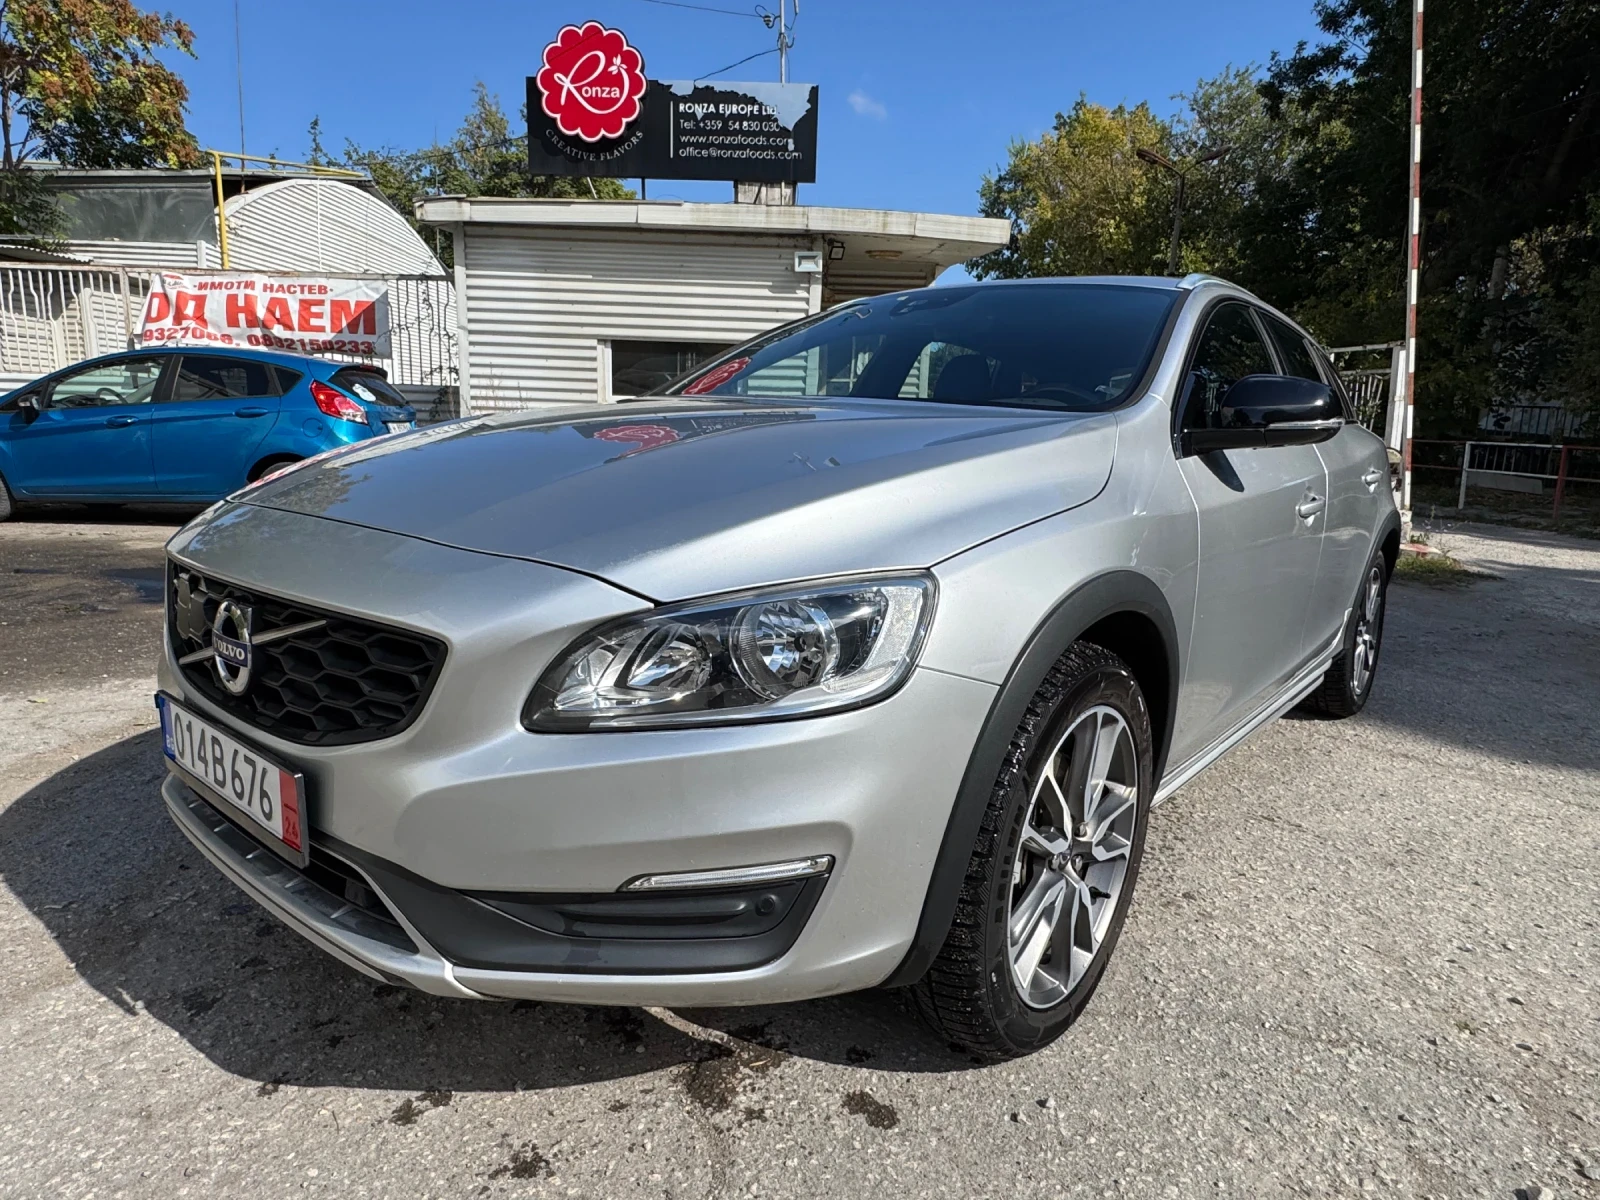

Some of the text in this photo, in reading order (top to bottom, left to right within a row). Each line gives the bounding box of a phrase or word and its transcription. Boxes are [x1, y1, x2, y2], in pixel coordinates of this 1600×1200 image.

[553, 50, 630, 114] Ronza
[679, 103, 716, 113] RONZA
[719, 104, 759, 115] EUROPE
[680, 120, 696, 130] Tel:
[699, 120, 722, 130] +359
[728, 121, 739, 131] 54
[742, 121, 760, 131] 830
[545, 129, 644, 161] CREATIVE FLAVORS
[679, 146, 802, 160] office@ronzafoods.com
[197, 281, 255, 291] ИМОТИ
[262, 283, 328, 295] НАСТЕВ
[225, 292, 377, 335] НАЕМ
[213, 636, 245, 660] VOLVO
[174, 712, 273, 822] 014B676
